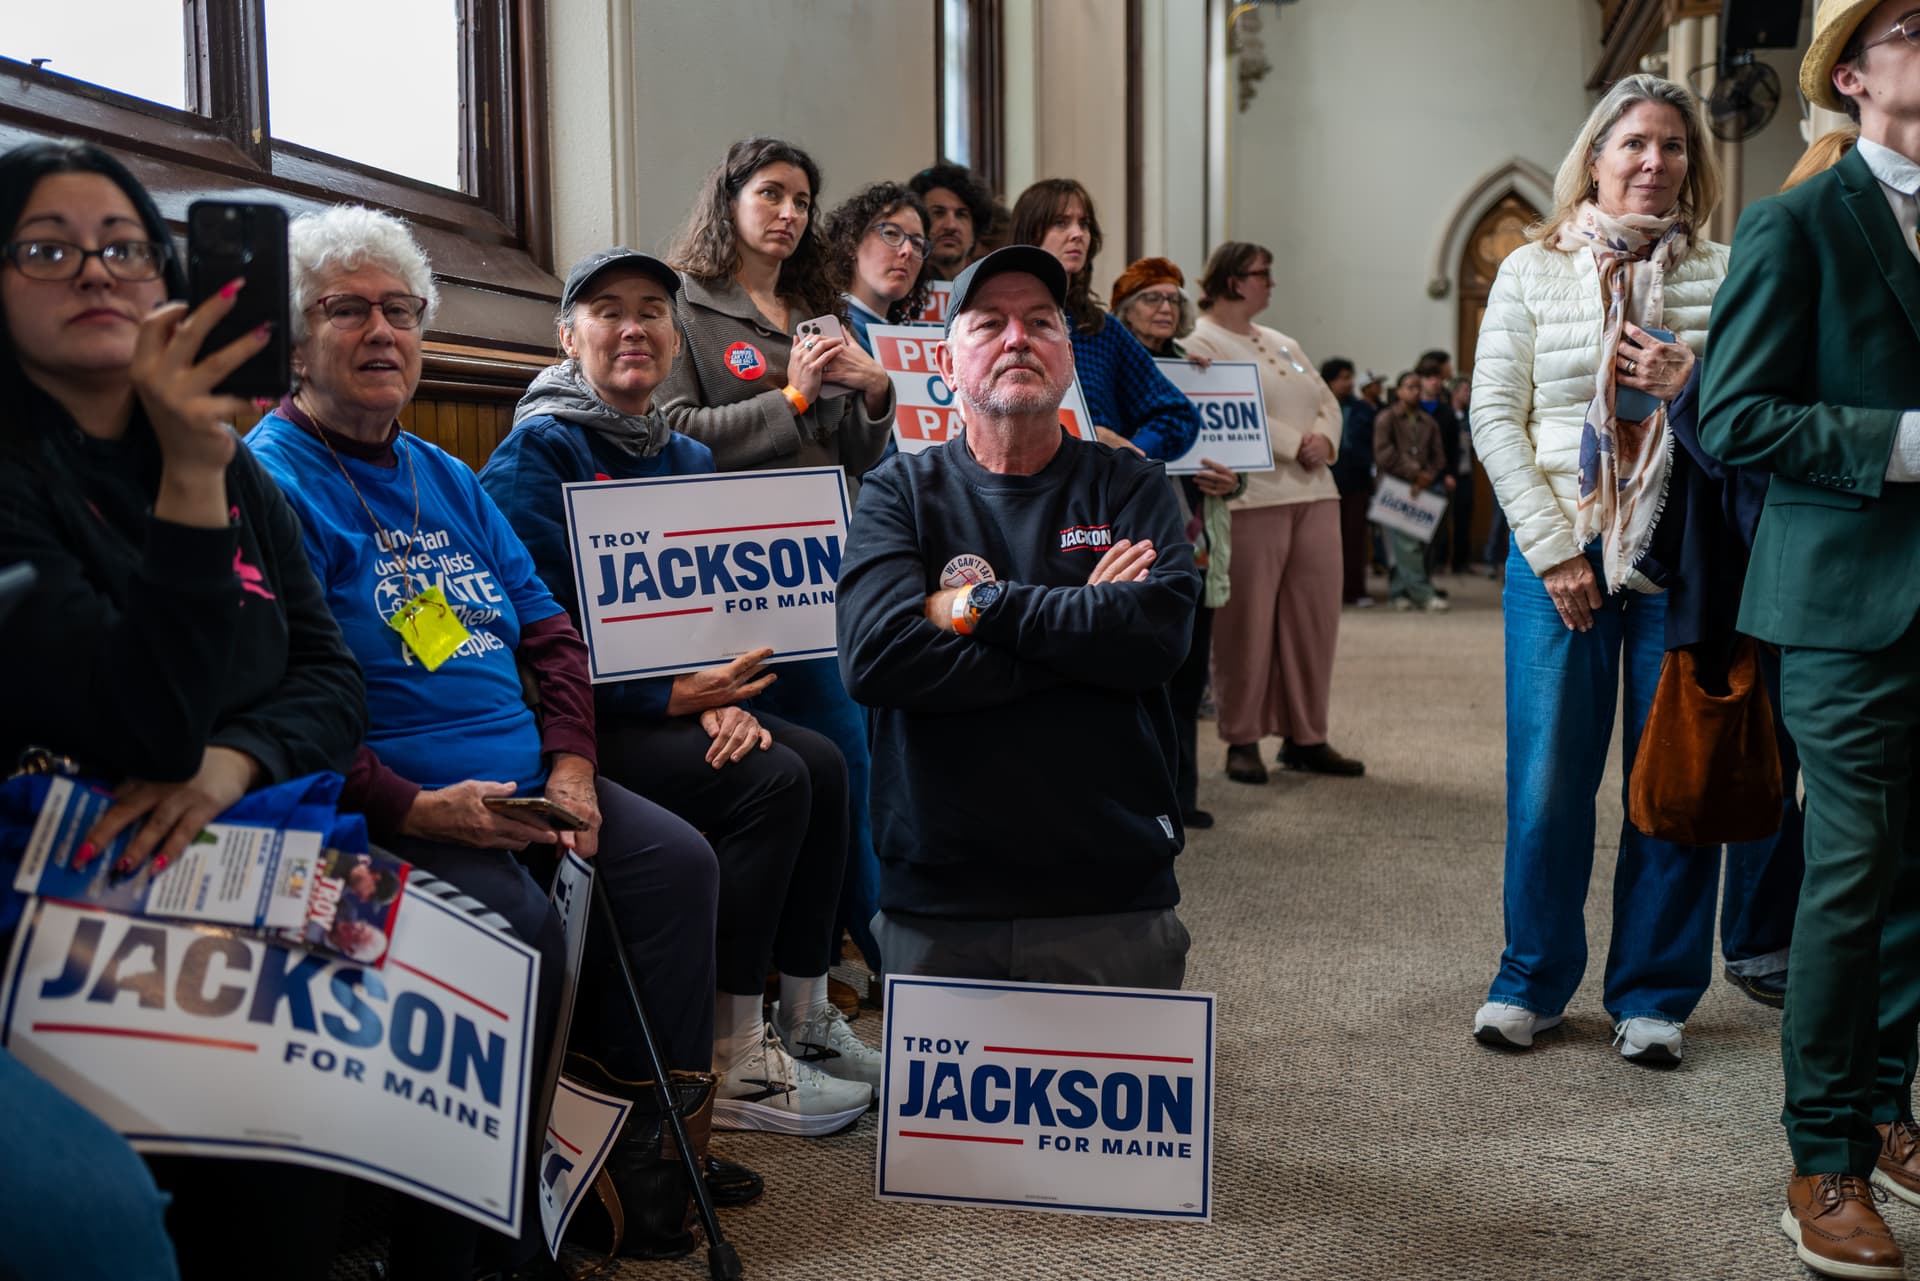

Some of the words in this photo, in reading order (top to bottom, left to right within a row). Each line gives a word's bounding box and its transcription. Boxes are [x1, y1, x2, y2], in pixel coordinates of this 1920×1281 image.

[1202, 433, 1224, 442] FOR
[1227, 432, 1261, 442] MAINE
[589, 530, 650, 549] TROY
[597, 535, 842, 607] JACKSON
[945, 562, 959, 575] WE
[957, 557, 981, 569] CAN'T
[979, 565, 993, 579] EAT
[725, 596, 769, 614] FOR
[777, 590, 836, 609] MAIN
[40, 917, 507, 1110] JACKSON
[903, 1036, 971, 1056] TROY
[283, 1041, 365, 1084] FOR
[383, 1070, 501, 1140] MAINE
[900, 1059, 1194, 1136] JACKSON
[1038, 1134, 1091, 1153] FOR
[1101, 1138, 1193, 1159] MAINE
